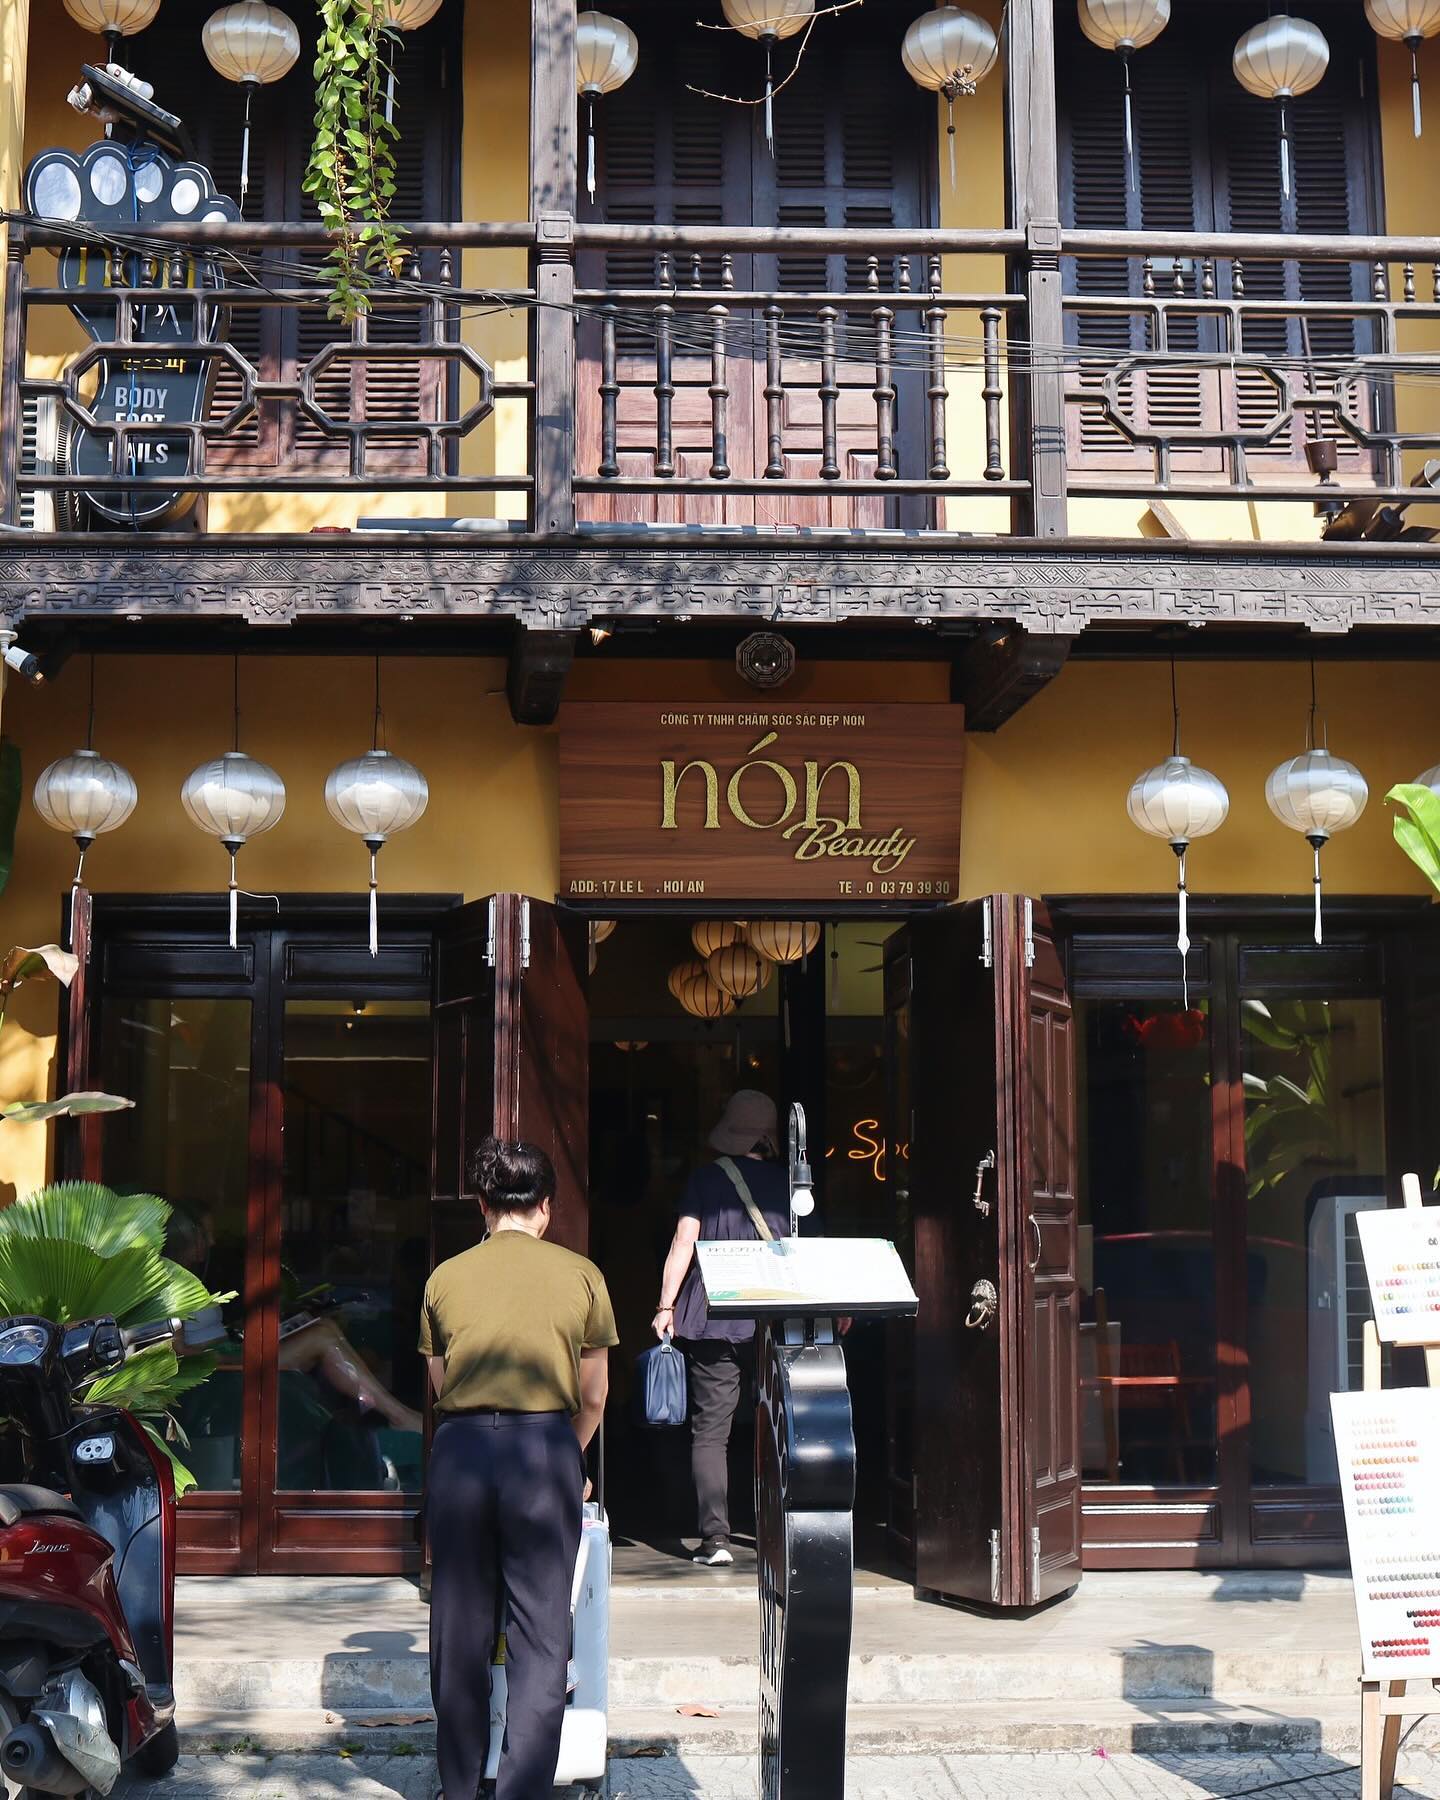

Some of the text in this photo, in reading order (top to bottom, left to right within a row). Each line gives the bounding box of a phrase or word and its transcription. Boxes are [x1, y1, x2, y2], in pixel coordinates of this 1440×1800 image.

[115, 386, 168, 409] BODY
[692, 714, 704, 726] TY
[707, 714, 735, 726] TNHH
[660, 731, 862, 829] nón
[782, 817, 916, 875] Beauty
[570, 880, 598, 893] ADD:
[602, 880, 616, 893] 17
[687, 880, 705, 893] AN
[899, 881, 913, 894] 79
[917, 881, 932, 894] 39
[935, 881, 950, 894] 30
[24, 1540, 71, 1555] Janus
